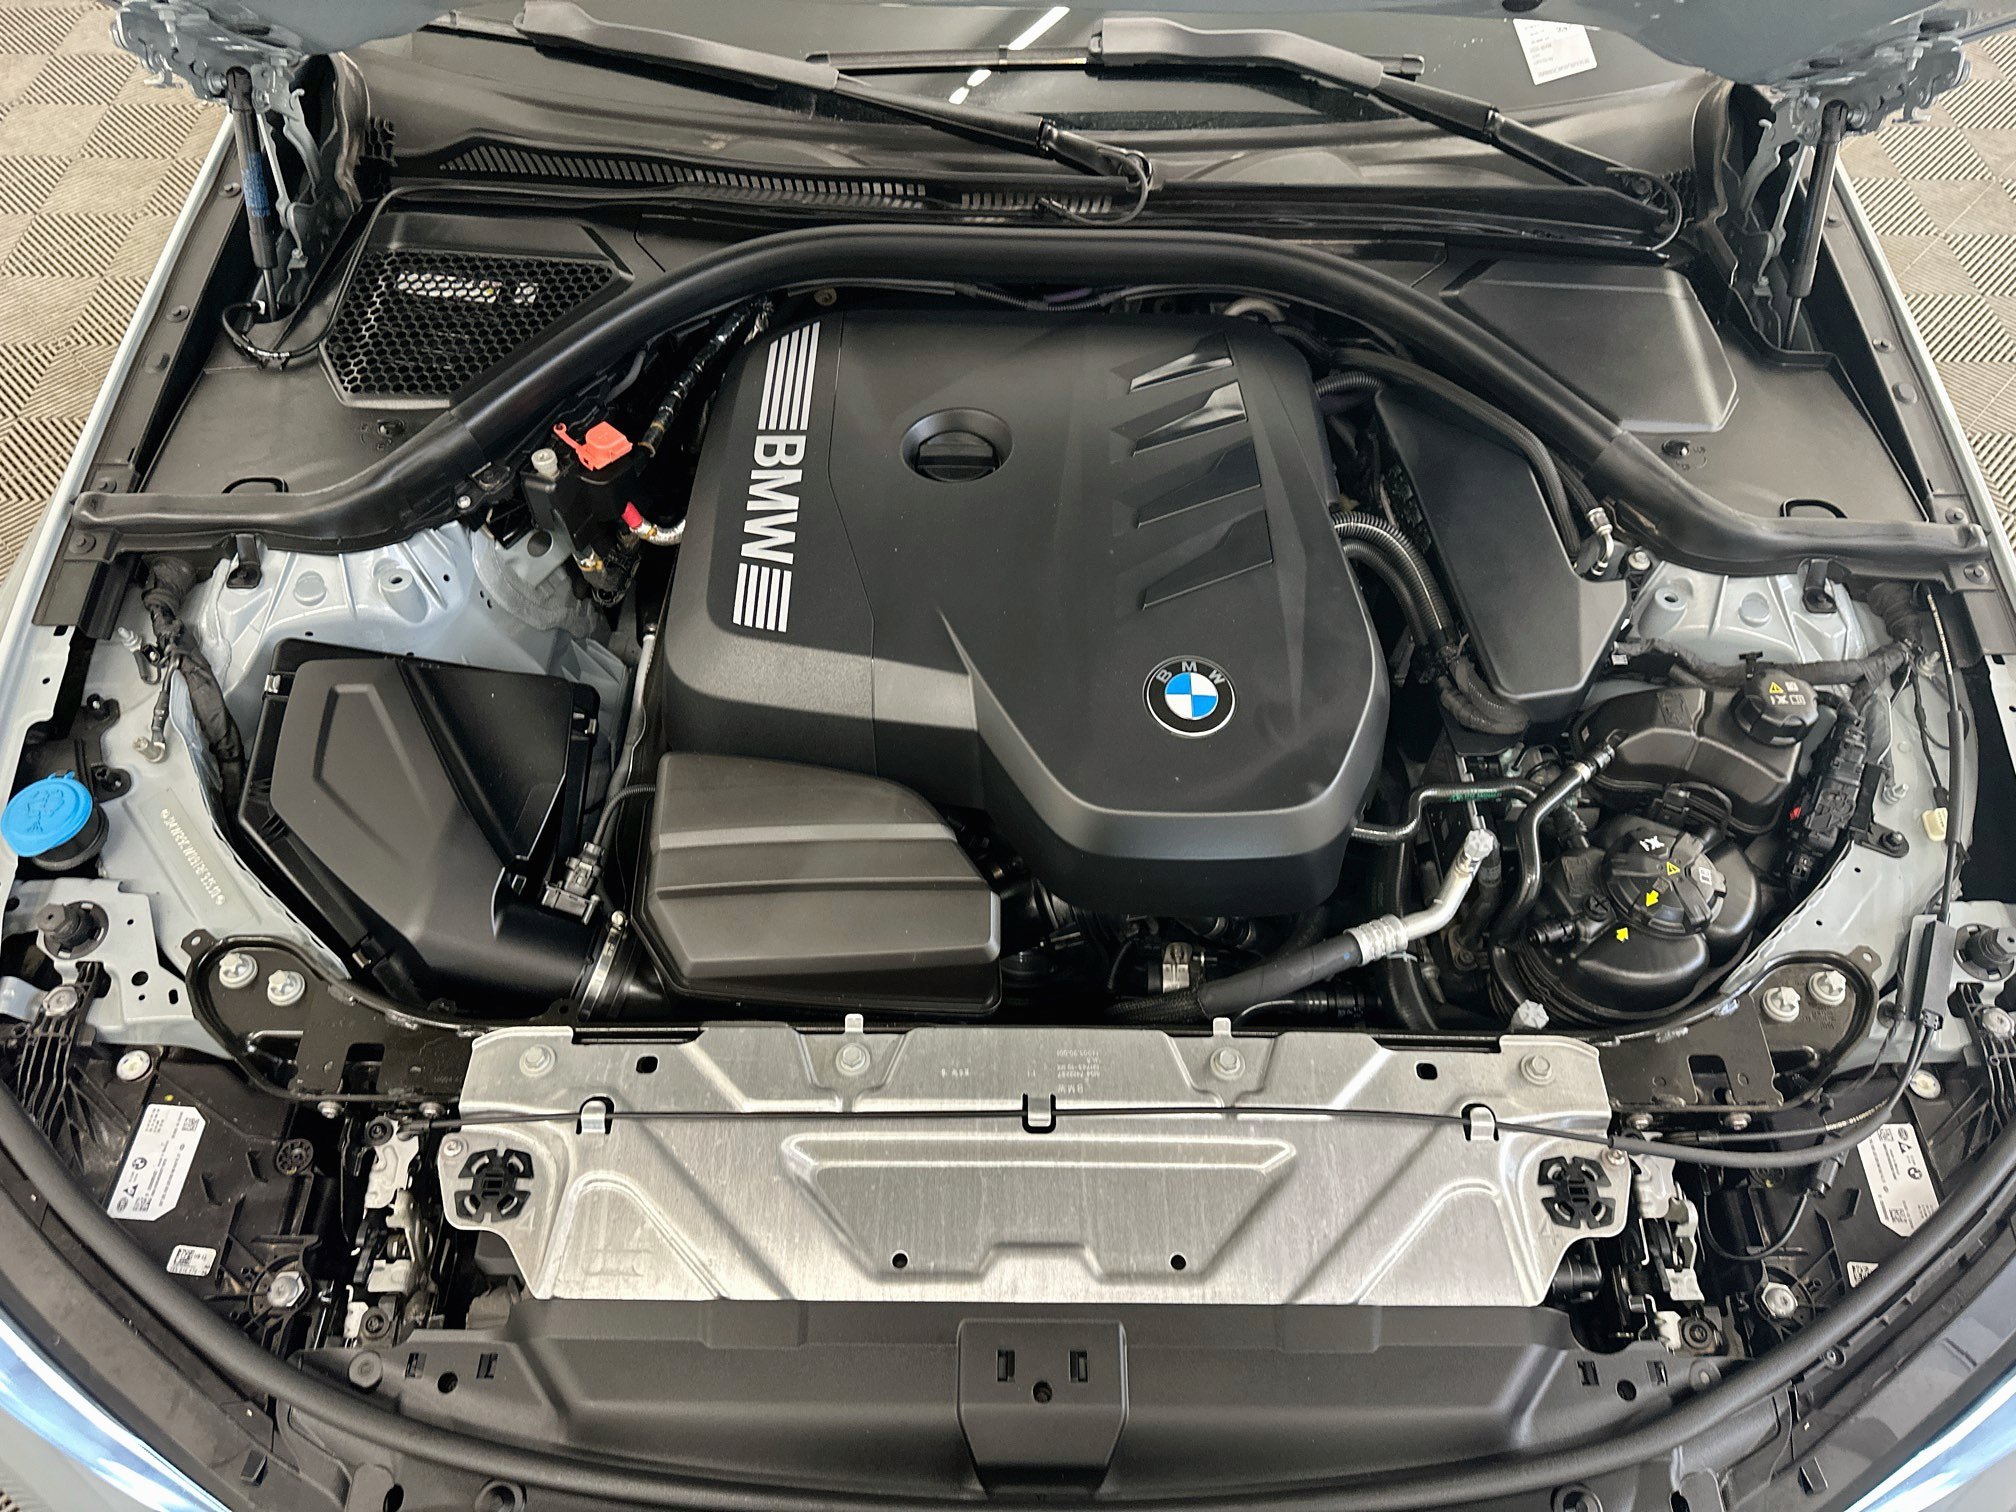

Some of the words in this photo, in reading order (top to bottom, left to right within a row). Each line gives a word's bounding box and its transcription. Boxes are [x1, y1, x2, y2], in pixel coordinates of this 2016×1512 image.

[741, 434, 807, 565] BMW
[1155, 661, 1226, 686] BMW
[1057, 1083, 1083, 1094] BMW
